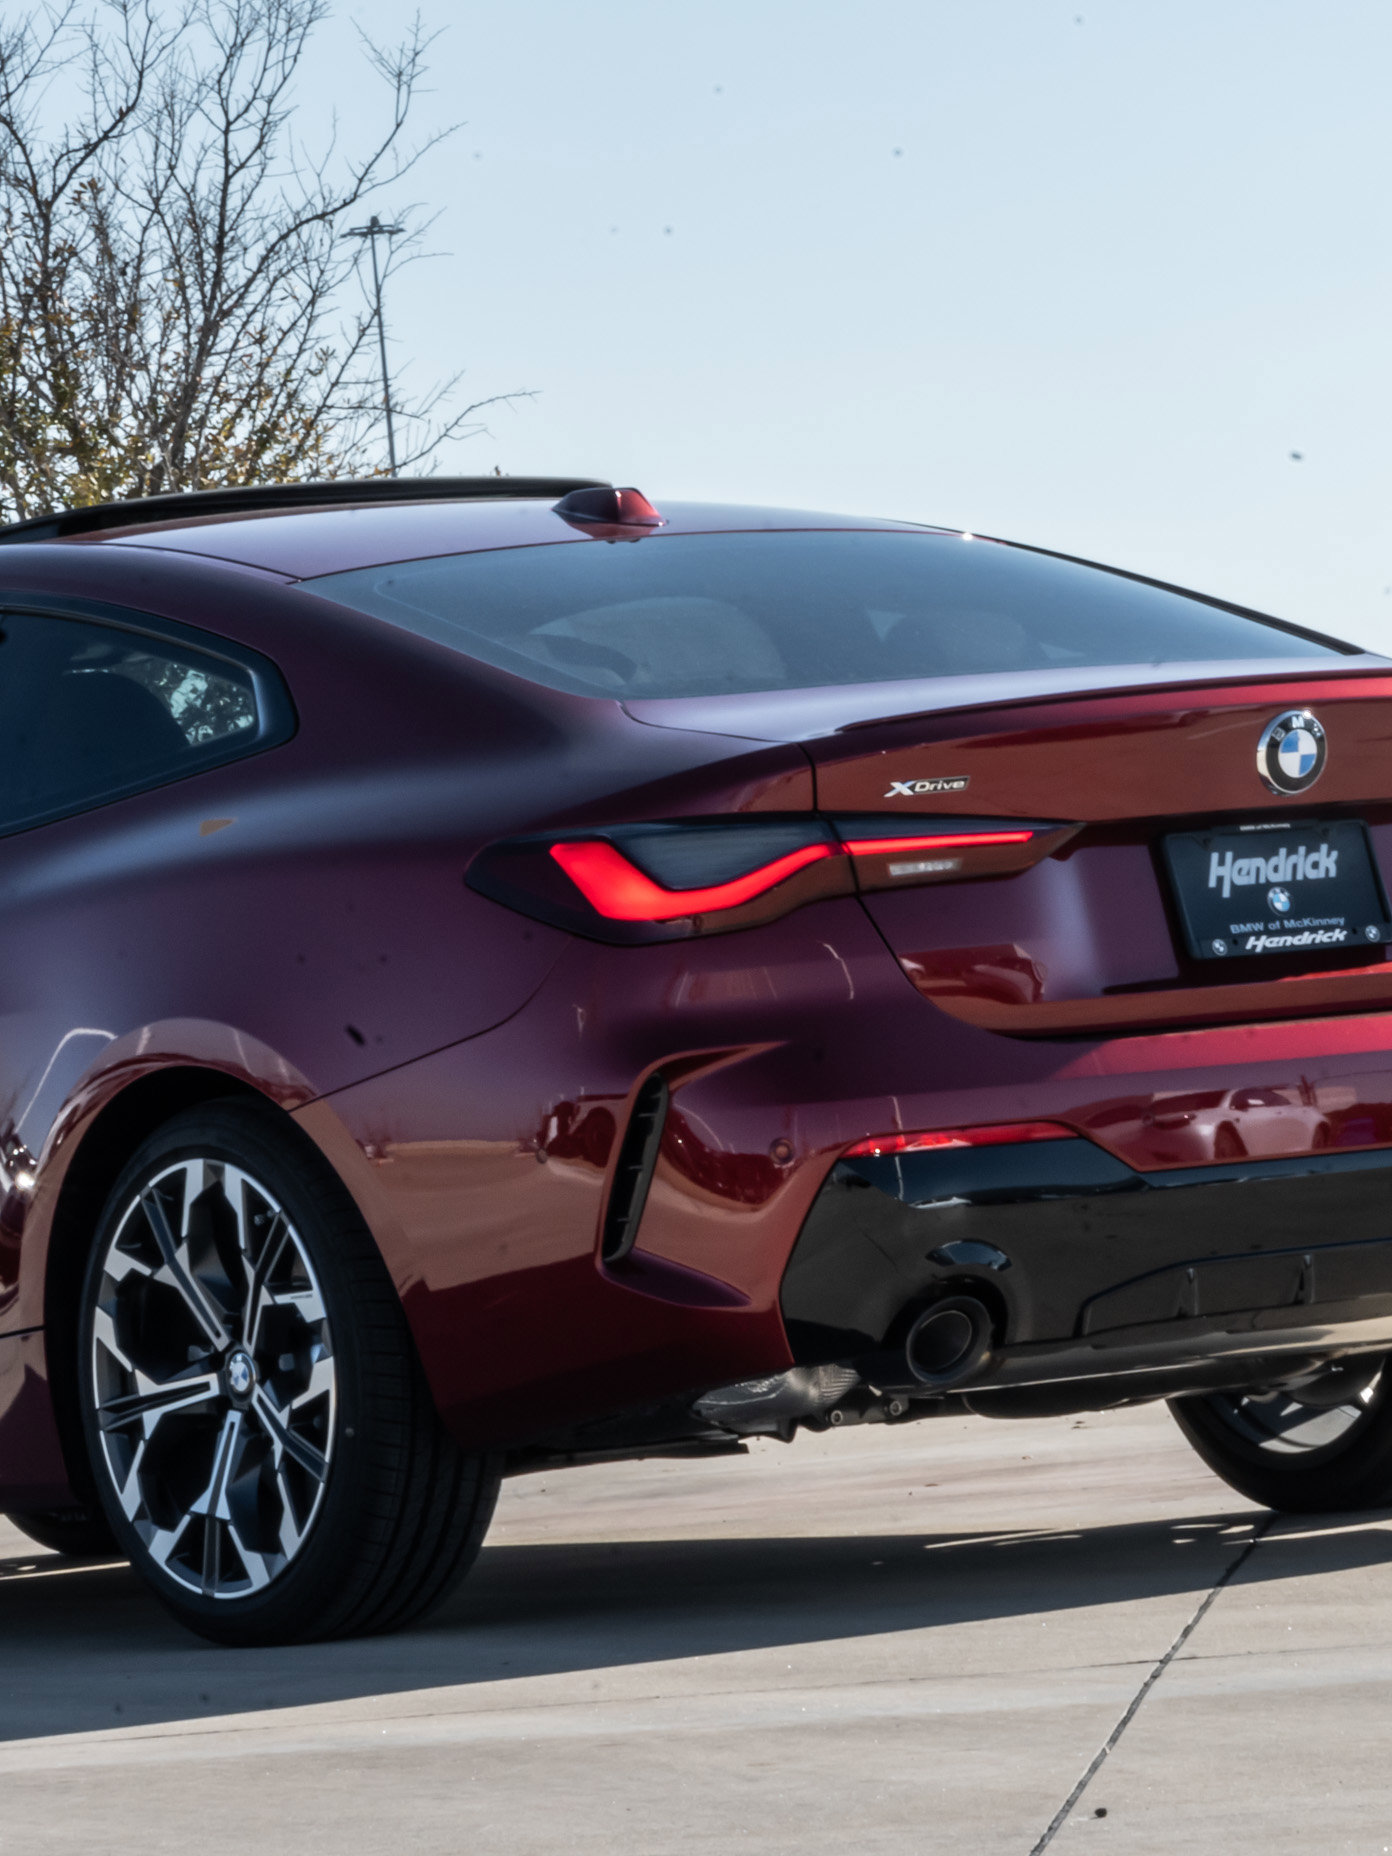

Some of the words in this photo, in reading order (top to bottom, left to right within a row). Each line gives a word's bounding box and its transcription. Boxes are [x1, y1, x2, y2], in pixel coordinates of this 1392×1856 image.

[1208, 843, 1338, 897] Hendrick
[1229, 922, 1264, 934] BMW
[1267, 920, 1281, 931] of
[1283, 917, 1345, 929] McKinney
[1245, 928, 1348, 953] Hendrick
